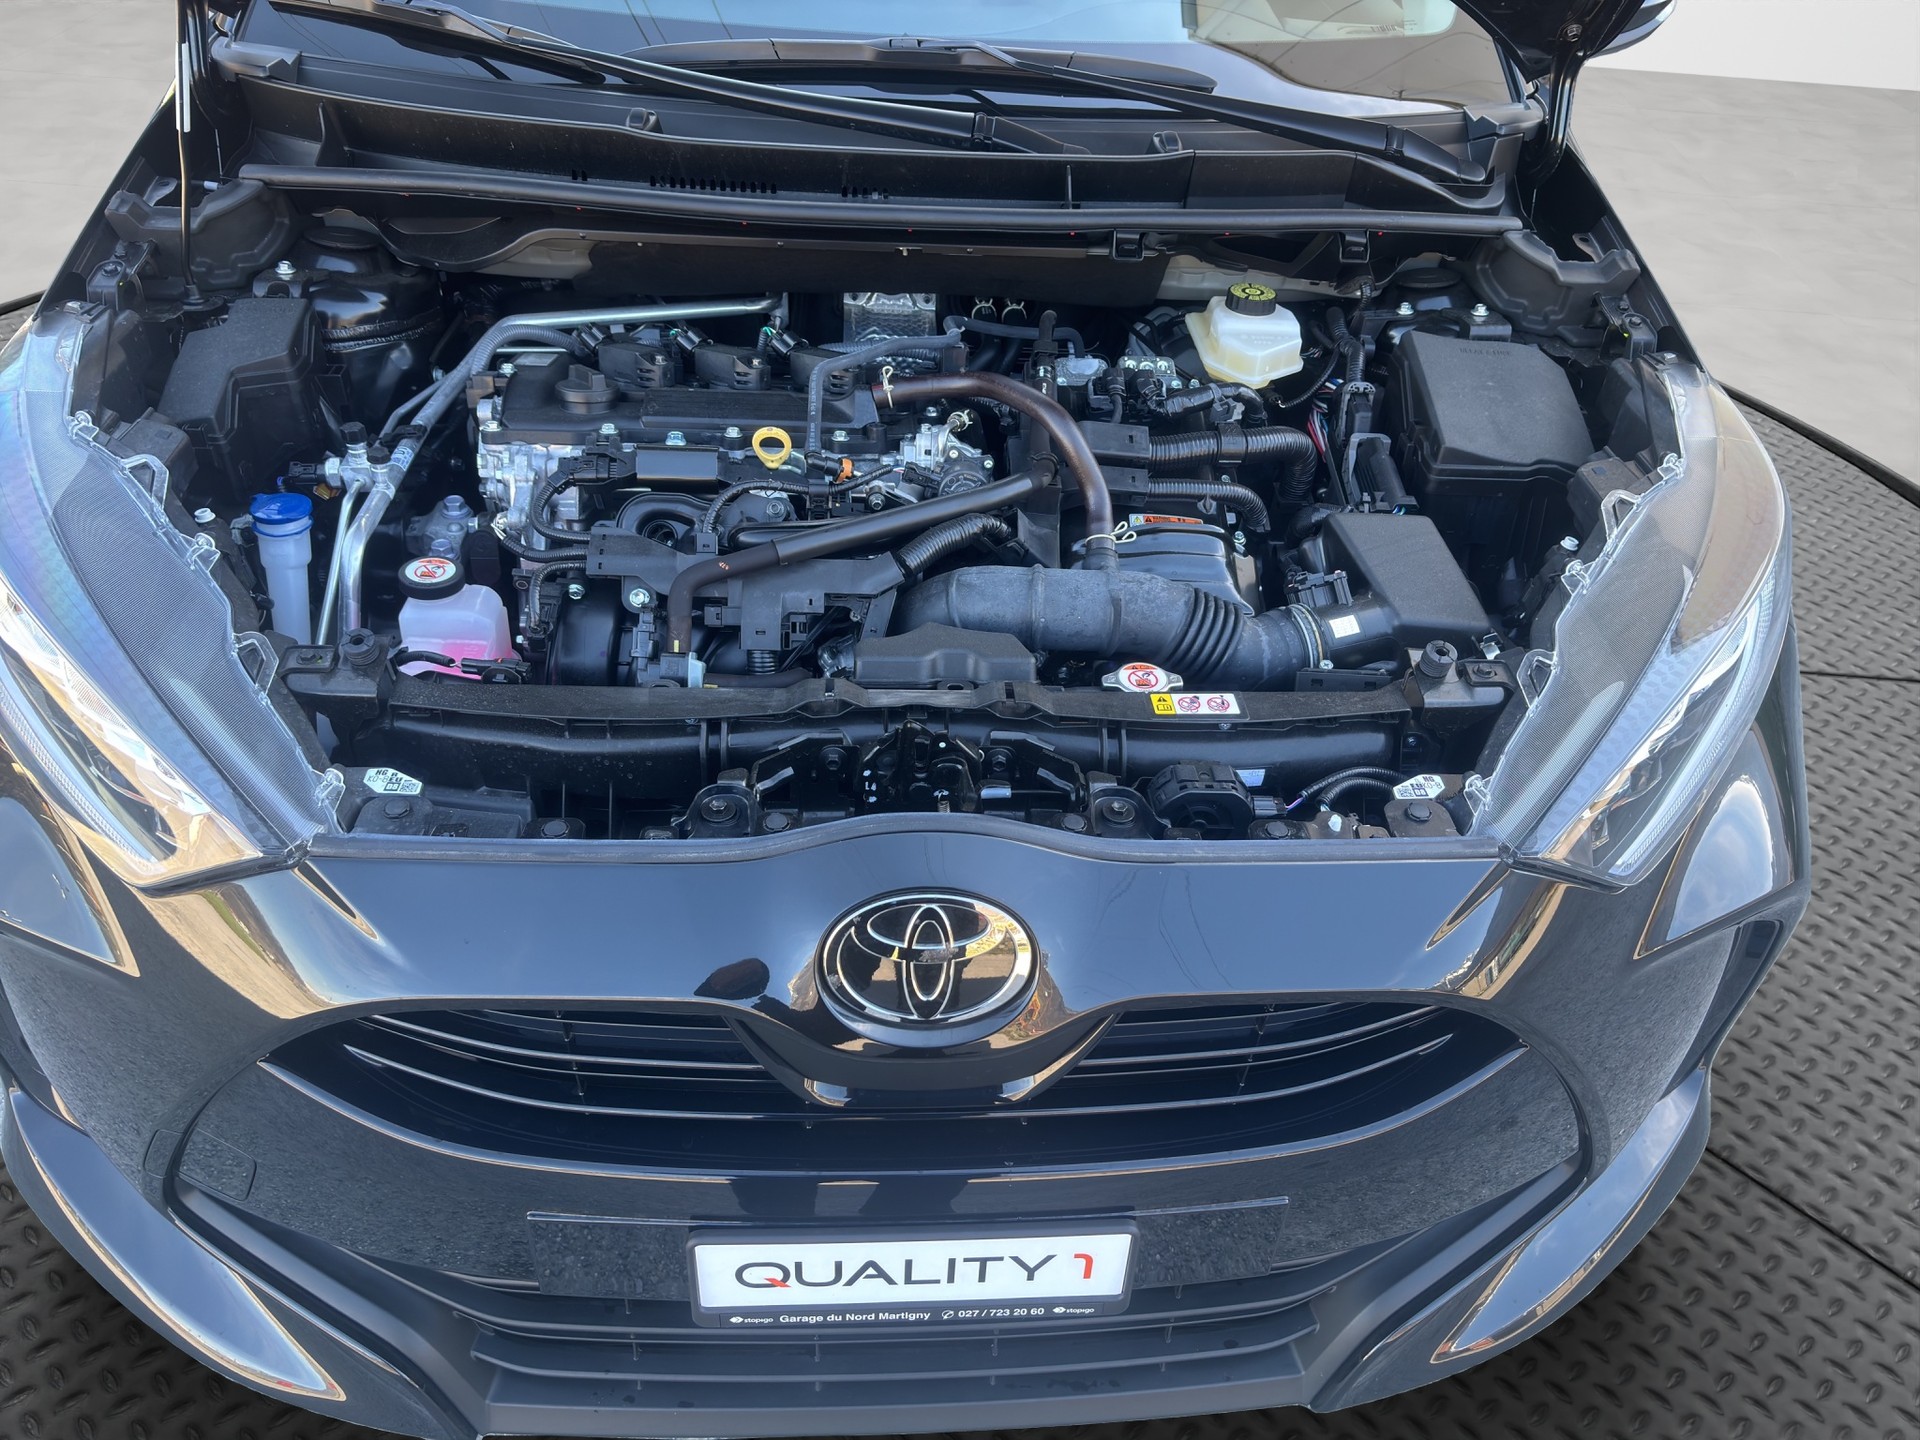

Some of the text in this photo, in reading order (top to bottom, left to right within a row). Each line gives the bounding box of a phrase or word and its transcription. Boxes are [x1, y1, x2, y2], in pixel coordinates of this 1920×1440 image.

[735, 1253, 1094, 1289] QUALITY 1
[779, 1307, 1045, 1323] Garage du Nord Martigny 027 / 723 20 60
